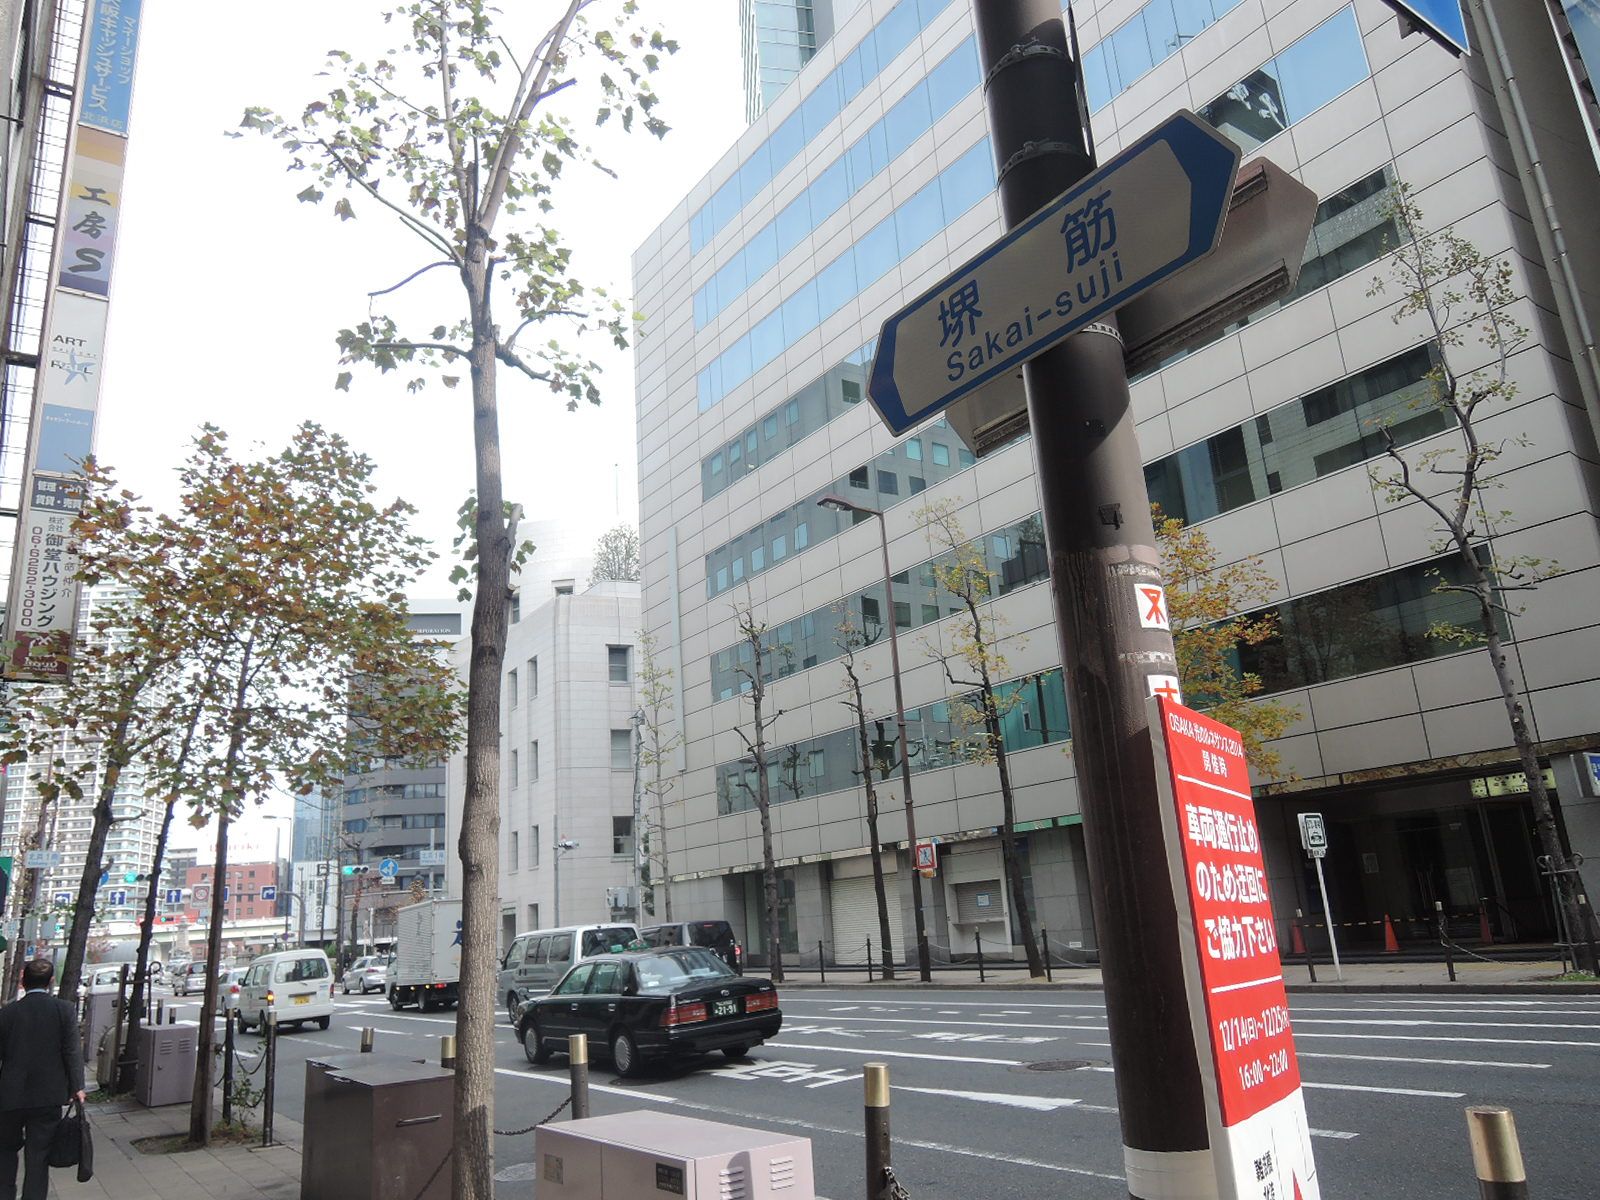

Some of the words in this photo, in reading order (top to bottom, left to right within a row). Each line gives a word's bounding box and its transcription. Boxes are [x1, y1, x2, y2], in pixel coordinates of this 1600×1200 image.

[946, 250, 1124, 382] Sakai-suji
[53, 334, 87, 347] ART
[37, 533, 63, 628] 御堂ハウジング
[1185, 803, 1259, 854] 車両通行止め
[1195, 861, 1267, 904] のため迂回に
[1204, 916, 1276, 961] ご協力下さい
